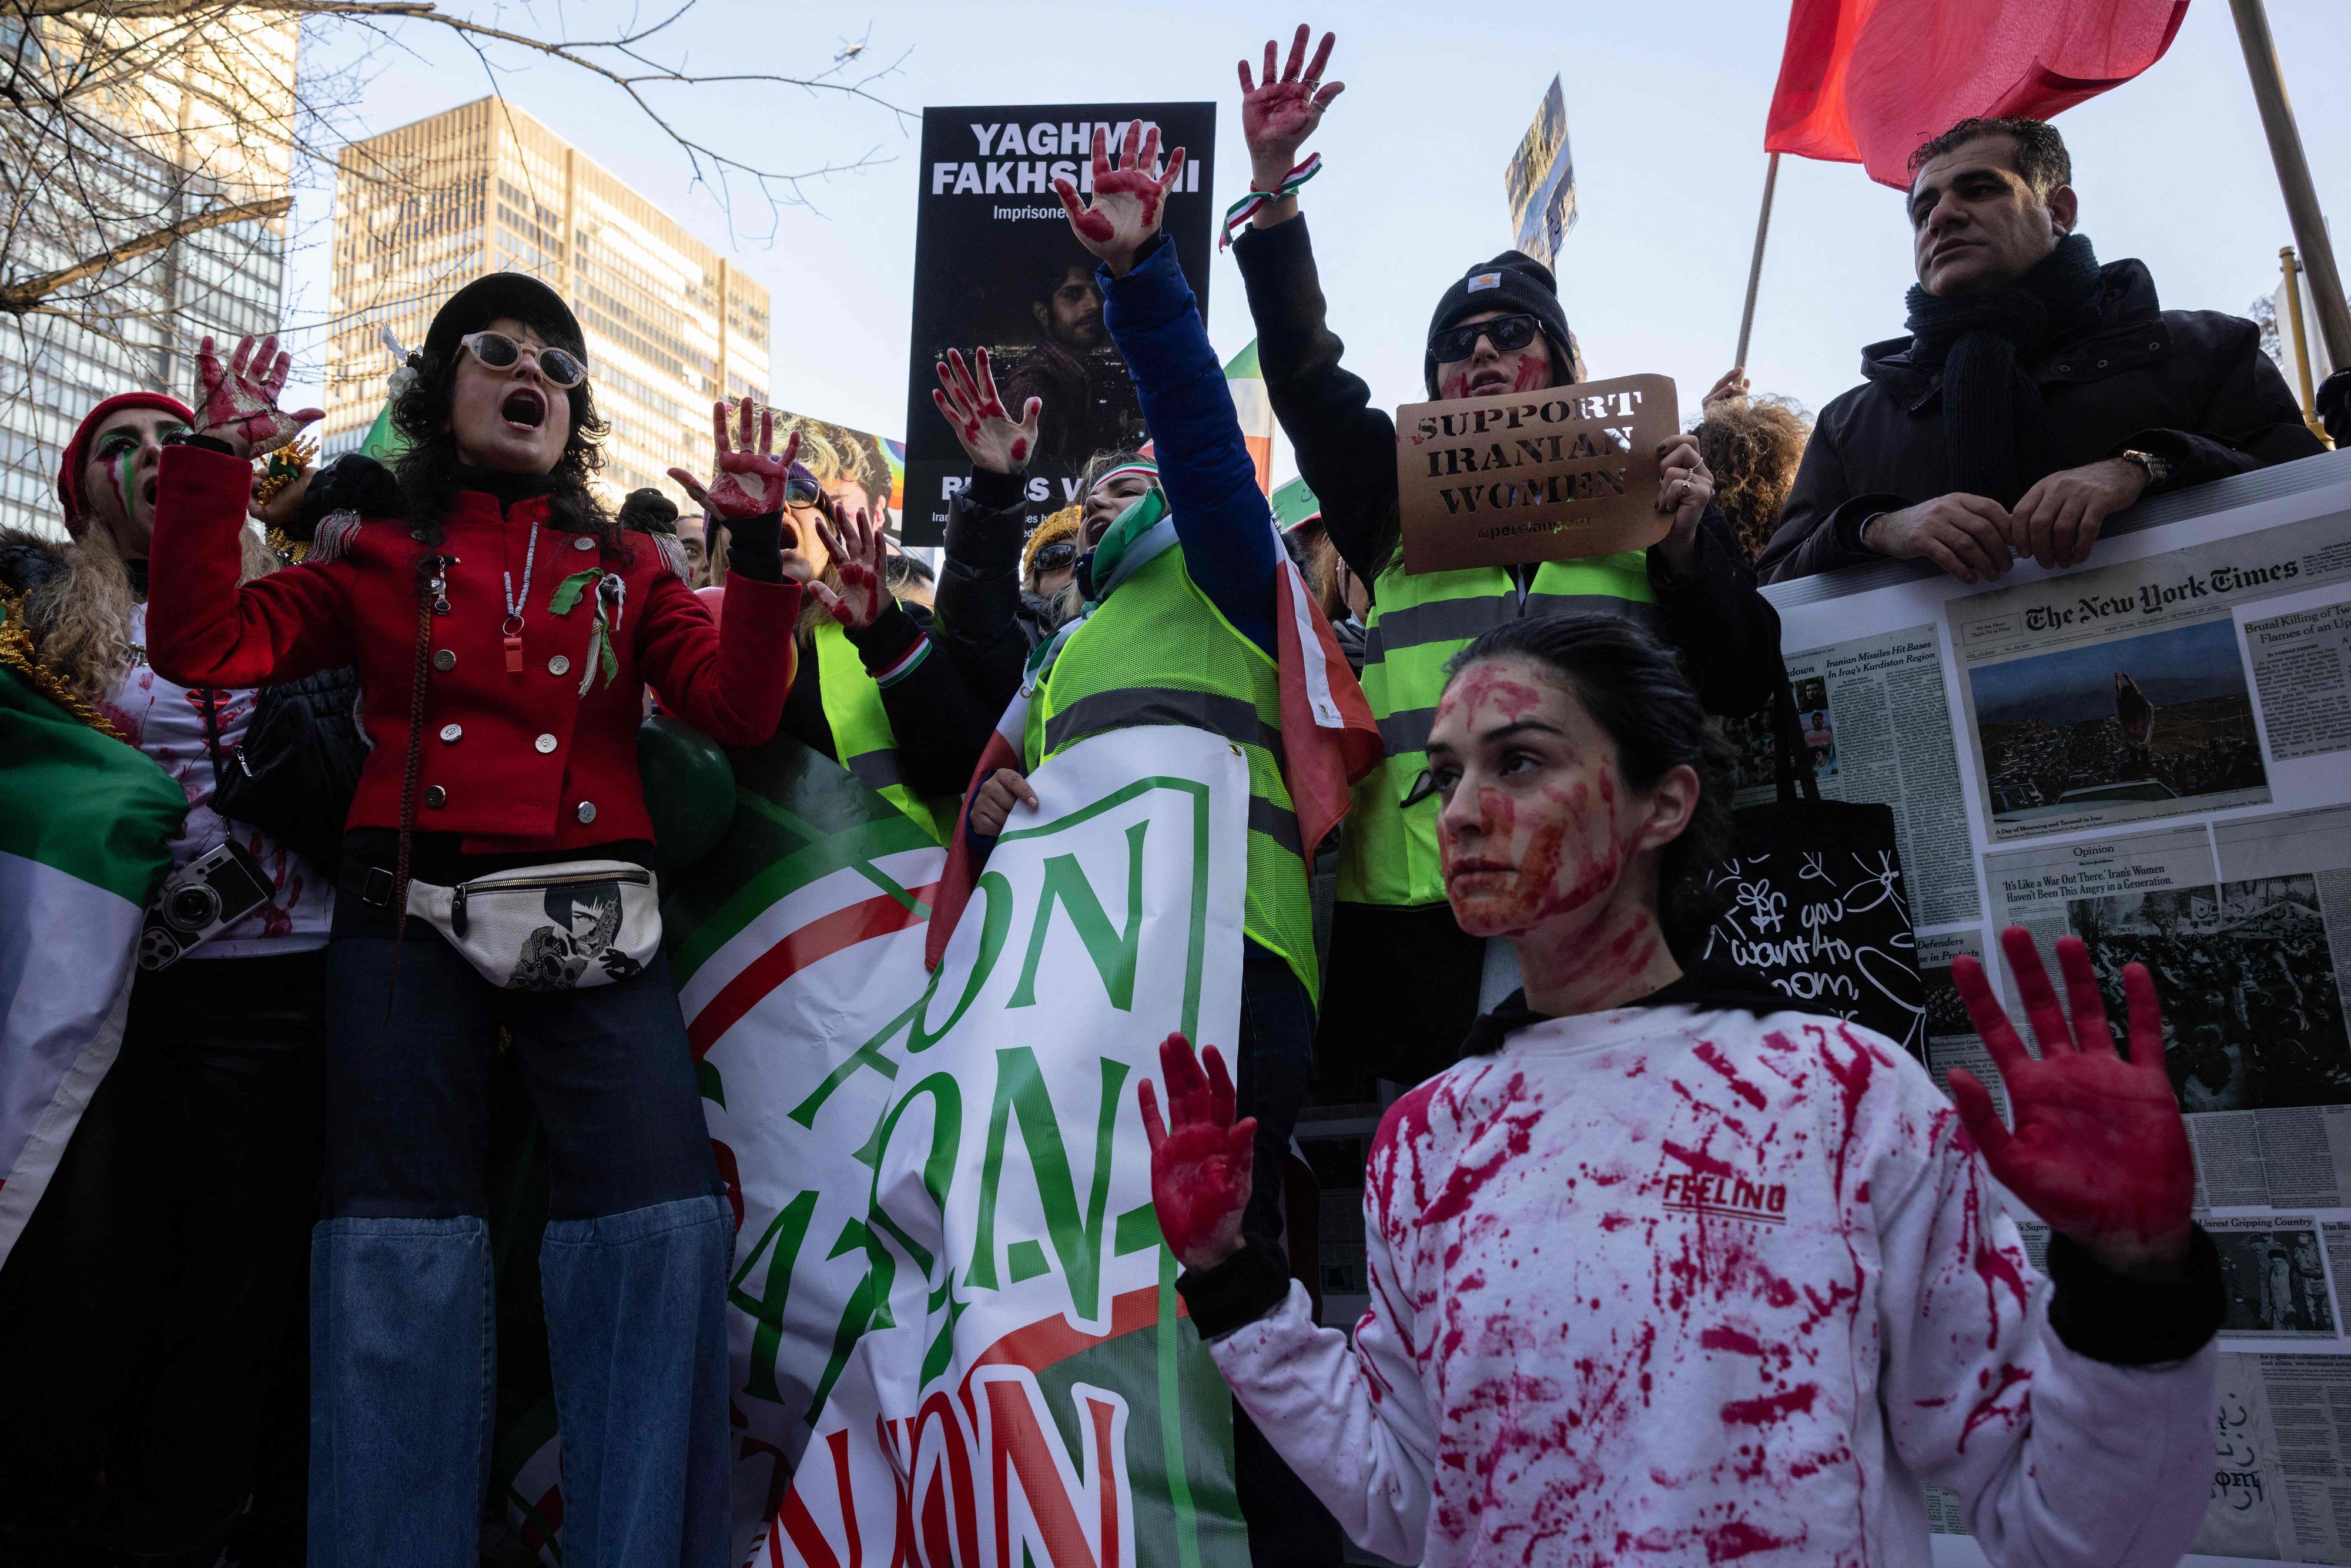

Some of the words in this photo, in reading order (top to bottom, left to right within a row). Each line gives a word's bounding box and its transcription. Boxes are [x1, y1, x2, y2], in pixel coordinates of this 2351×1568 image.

[1417, 391, 1642, 440] SUPPORT
[1427, 427, 1633, 478] IRANIAN
[1439, 468, 1626, 515] WOMEN
[2026, 605, 2076, 631] The
[2078, 596, 2135, 624] New
[2139, 575, 2209, 614] York
[2211, 560, 2299, 592] Times
[2169, 609, 2196, 619] OCTOBER
[2245, 618, 2279, 633] Brutal
[2280, 612, 2319, 626] Killing
[2320, 608, 2332, 618] of
[2332, 606, 2351, 616] Tw
[2260, 629, 2300, 643] Flames
[2303, 625, 2315, 635] of
[2317, 624, 2331, 632] an
[1824, 656, 1856, 668] Iranian
[1857, 649, 1890, 661] Missiles
[1891, 645, 1905, 654] Hit
[1906, 641, 1931, 651] Bases
[1838, 665, 1861, 676] Iraq’s
[1863, 658, 1904, 671] Kurdistan
[1905, 652, 1935, 663] Region
[2274, 648, 2295, 656] FARNAZ
[2020, 823, 2047, 832] Mourning
[2059, 817, 2082, 826] Turmoil
[2072, 845, 2114, 859] Opinion
[2001, 881, 2016, 891] ‘It’s
[2018, 879, 2035, 889] Like
[2043, 876, 2059, 886] War
[2061, 875, 2076, 884] Out
[2077, 870, 2105, 882] There.’
[2108, 867, 2131, 879] Iran’s
[2132, 866, 2165, 876] Women
[2005, 890, 2035, 903] Haven’t
[2037, 889, 2058, 899] Been
[2059, 886, 2077, 897] This
[2079, 884, 2105, 896] Angry
[2106, 882, 2115, 891] in
[2124, 876, 2174, 889] Generation.
[1801, 899, 1843, 957] you
[1732, 936, 1810, 967] want
[1819, 936, 1851, 964] to
[1916, 937, 1964, 949] Defenders
[2198, 1219, 2228, 1227] Unrest
[2231, 1218, 2272, 1228] Gripping
[2274, 1218, 2312, 1228] Country
[2323, 1222, 2336, 1231] Iran
[2337, 1222, 2350, 1230] Has
